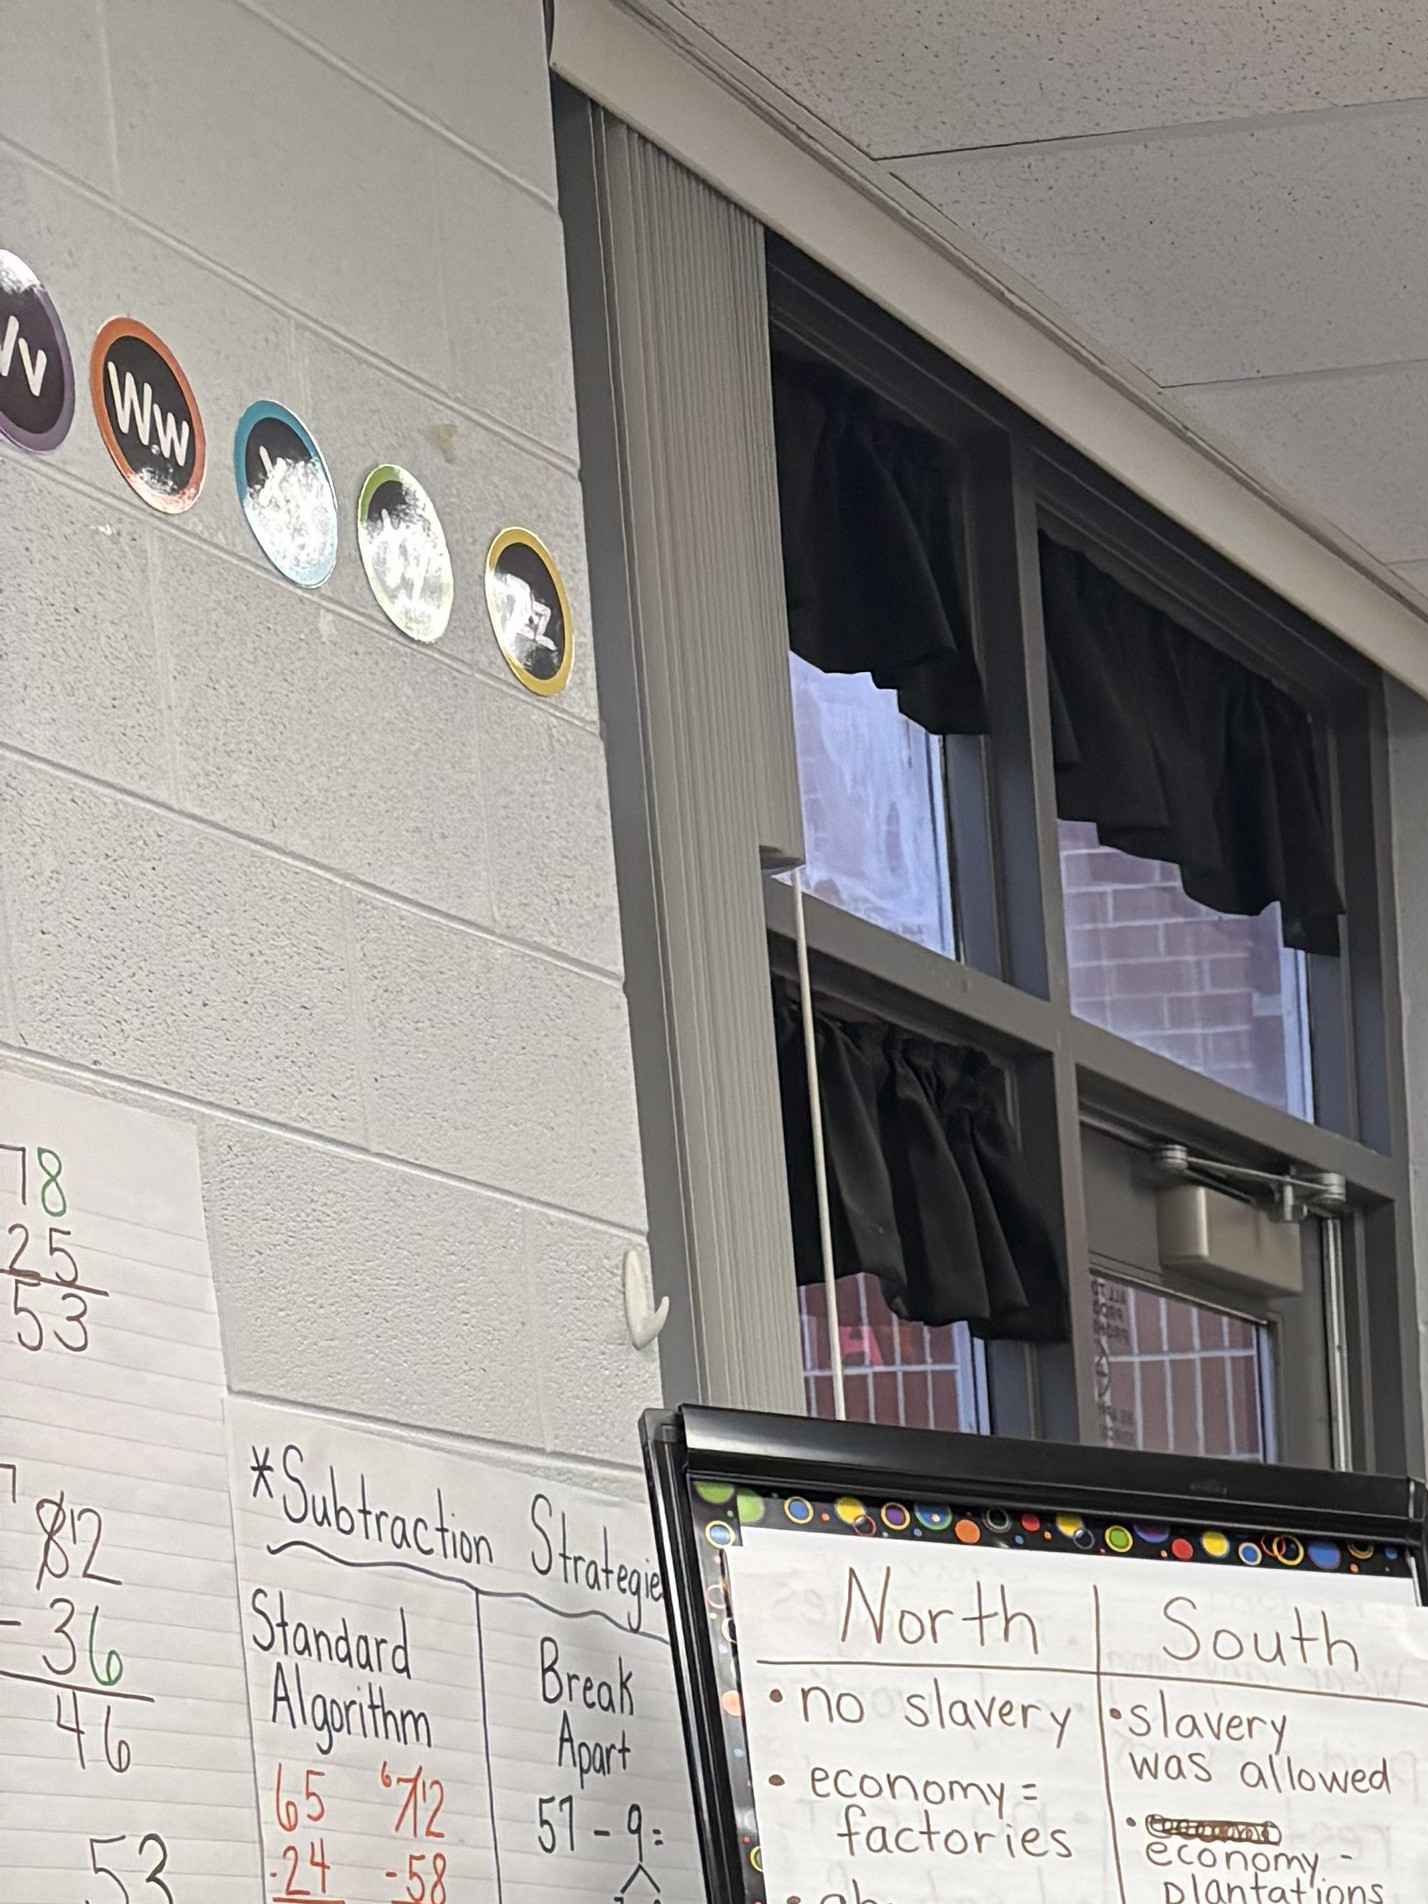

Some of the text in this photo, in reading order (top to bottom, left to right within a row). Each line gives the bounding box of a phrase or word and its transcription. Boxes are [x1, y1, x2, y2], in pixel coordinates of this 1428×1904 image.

[108, 361, 189, 467] Ww
[8, 1223, 78, 1286] 25
[14, 1279, 87, 1351] 53
[531, 1493, 665, 1632] Strategie
[43, 1598, 123, 1686] 36
[253, 1588, 634, 1715] Standard Break
[841, 1565, 1359, 1673] North South
[57, 1689, 130, 1772] 46
[272, 1662, 631, 1793] Algorithm Apart
[802, 1679, 1072, 1749] no slavery
[1128, 1690, 1287, 1762] slavery
[275, 1762, 326, 1832] 65
[810, 1769, 1007, 1811] economy
[1128, 1752, 1392, 1795] was allowed
[537, 1795, 575, 1854] 57
[836, 1806, 1073, 1861] factories
[1146, 1842, 1319, 1878] economy
